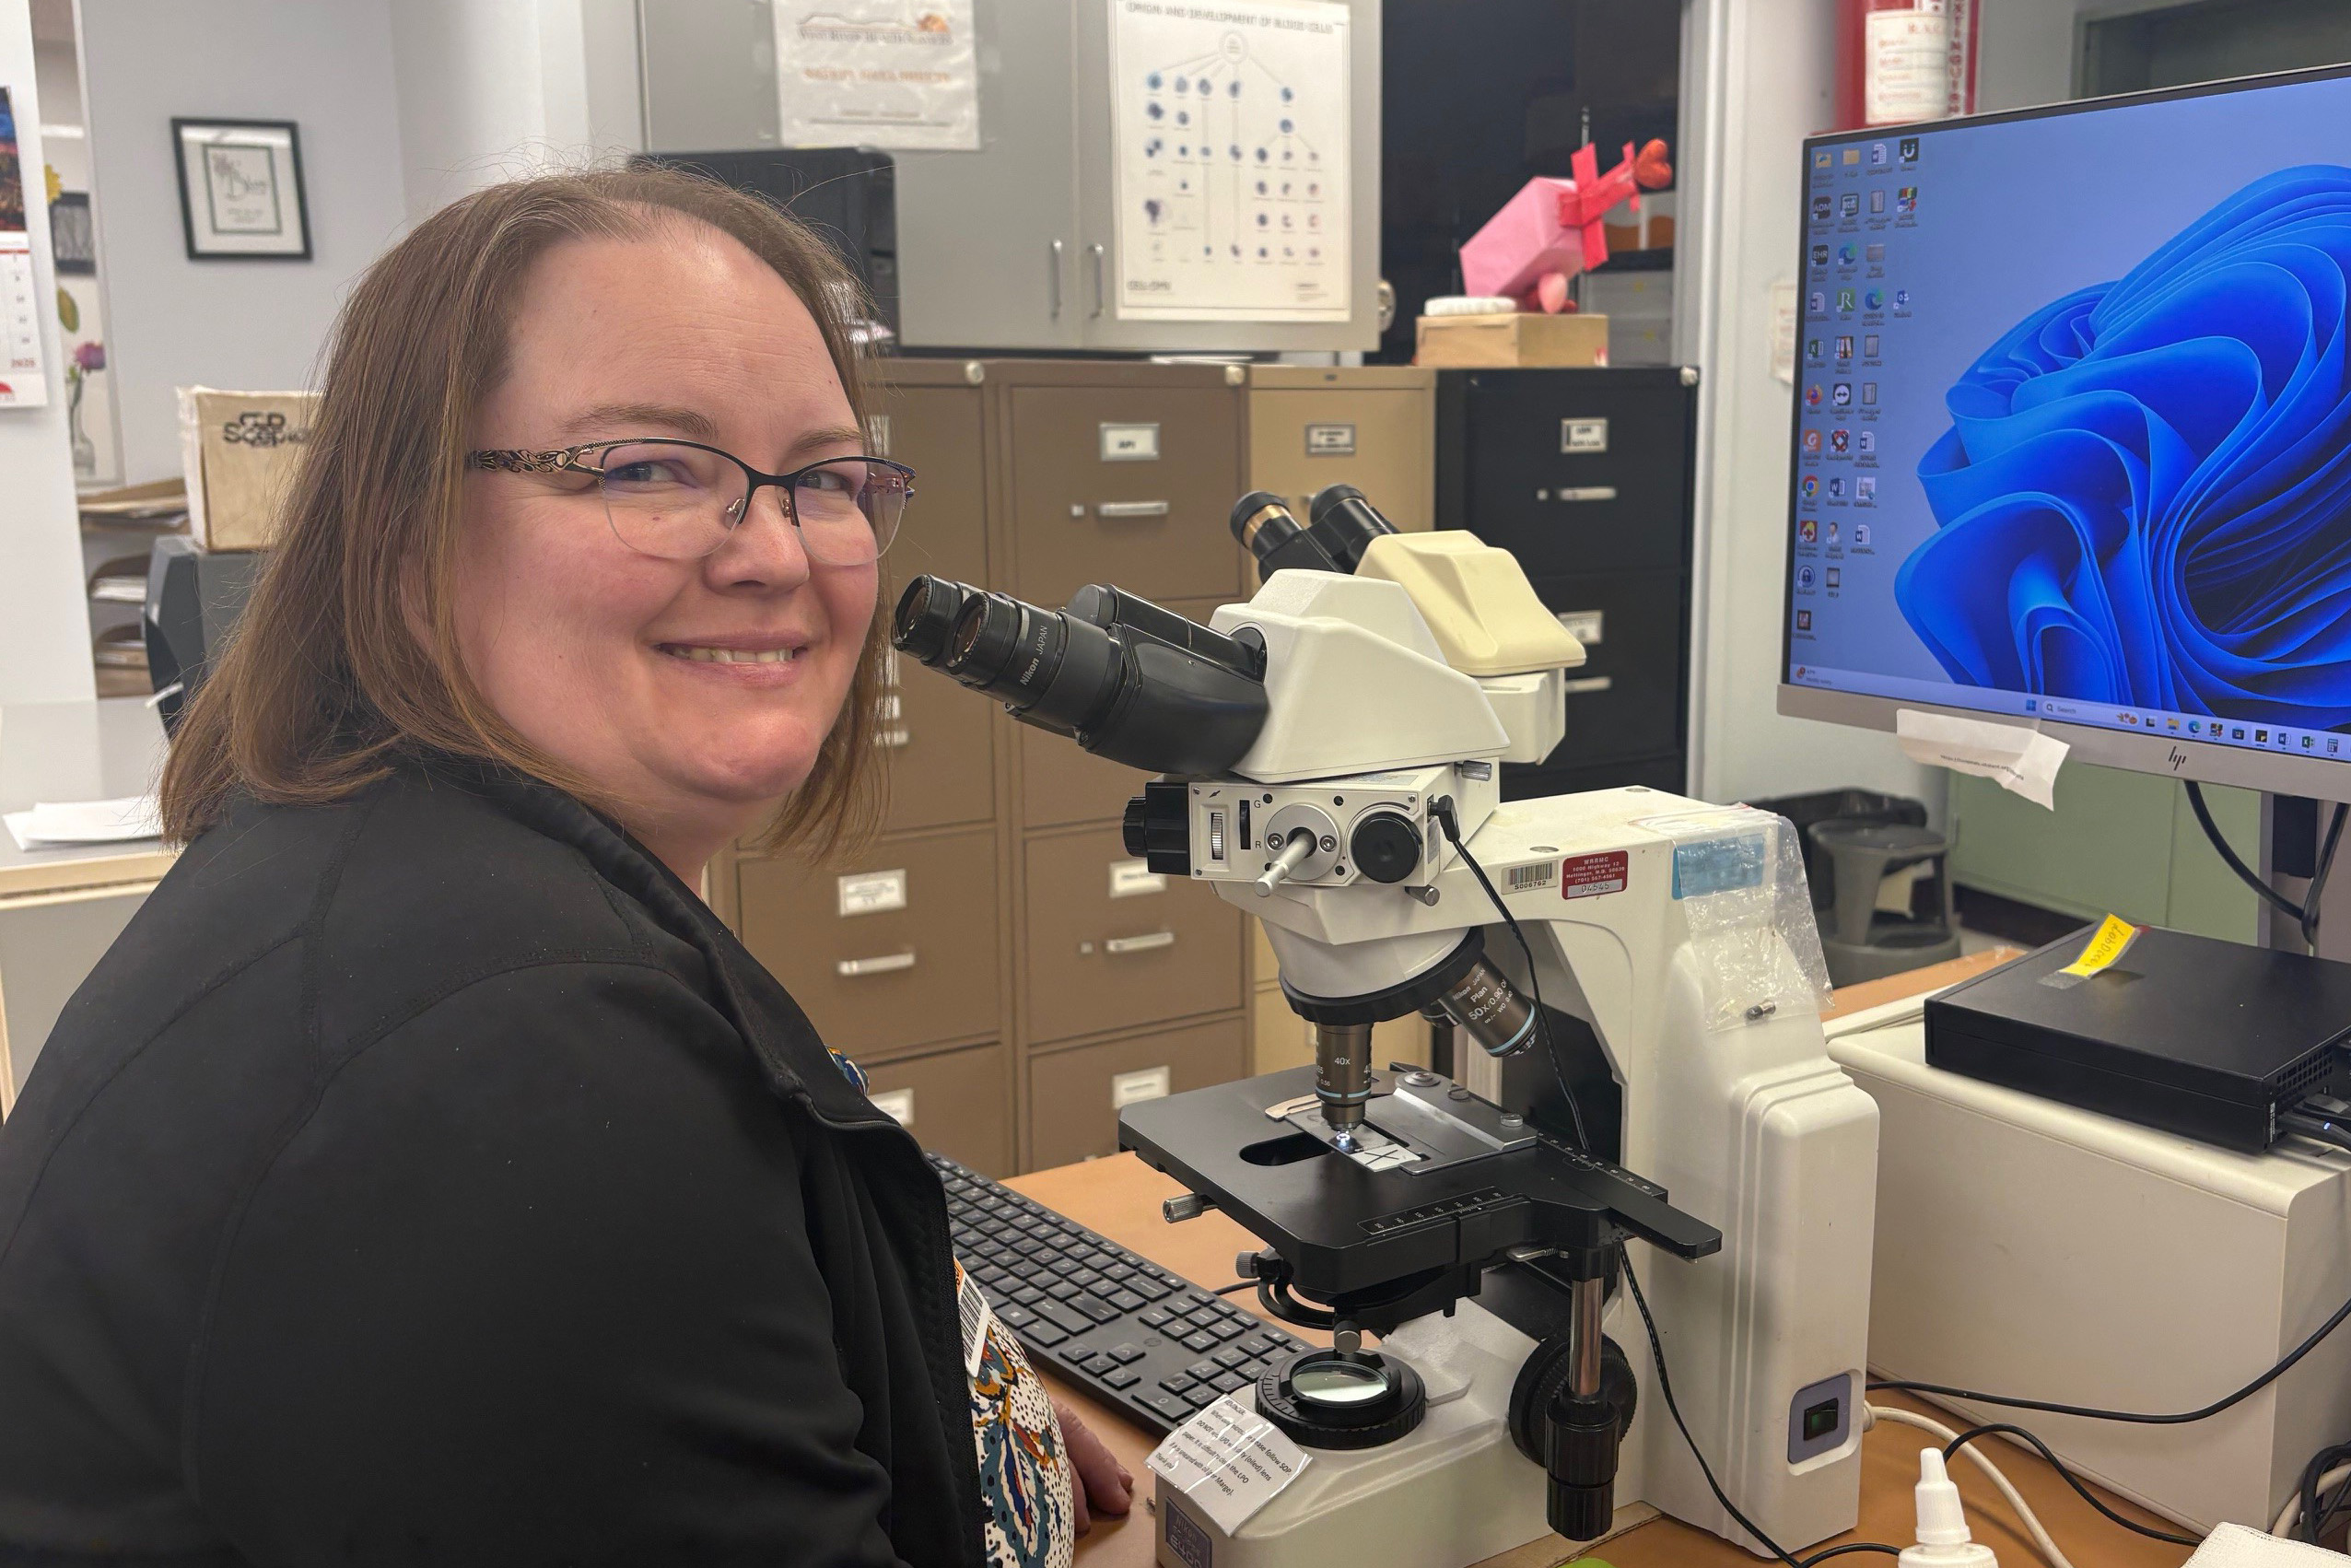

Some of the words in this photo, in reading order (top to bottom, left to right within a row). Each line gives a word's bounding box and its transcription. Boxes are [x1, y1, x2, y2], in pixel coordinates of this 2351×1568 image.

[1812, 250, 1828, 260] EHR
[1019, 657, 1040, 685] Nikon
[1035, 625, 1047, 655] JAPAN
[1254, 800, 1261, 808] G
[1255, 840, 1261, 848] R
[1515, 880, 1547, 890] S006762
[1452, 986, 1471, 1001] Nikon
[1472, 967, 1485, 986] JAPAN
[1468, 987, 1503, 1020] 50x/0.90
[1469, 986, 1488, 1003] Plan
[1334, 1057, 1351, 1065] 40x
[1197, 1420, 1205, 1428] DO
[1204, 1424, 1214, 1434] NOT
[1245, 1455, 1264, 1474] (oiled)
[1261, 1469, 1272, 1482] lens
[1265, 1447, 1281, 1466] follow
[1229, 1464, 1240, 1476] the
[1237, 1473, 1250, 1485] LPO
